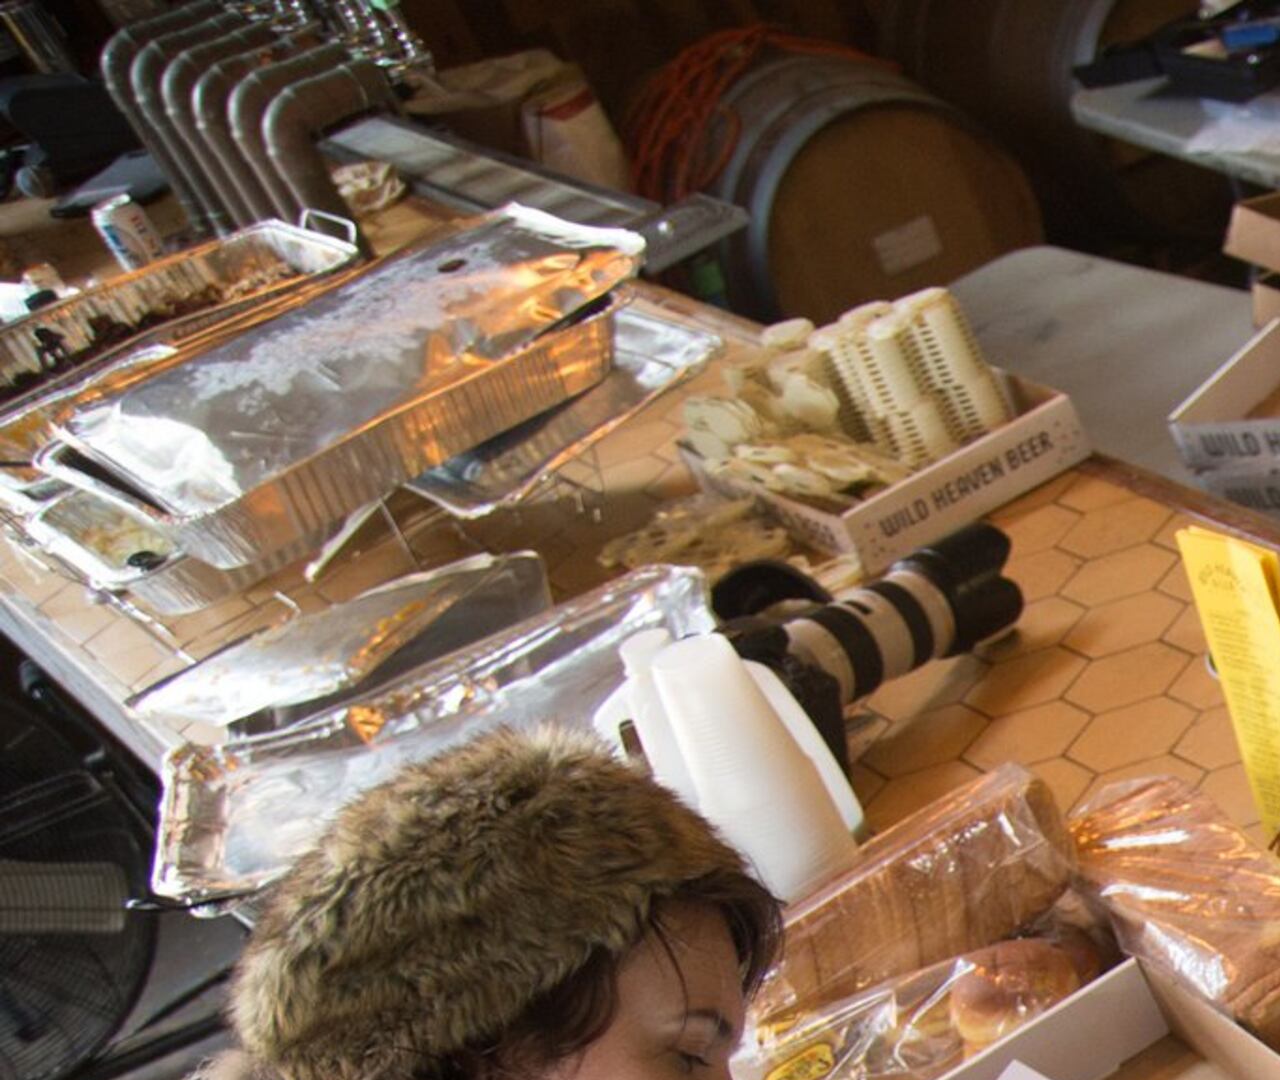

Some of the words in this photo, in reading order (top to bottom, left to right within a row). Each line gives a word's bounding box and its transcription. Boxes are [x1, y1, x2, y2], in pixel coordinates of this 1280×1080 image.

[1202, 429, 1262, 457] WILD
[878, 498, 931, 538] WILD
[934, 458, 1006, 513] HEAVEN
[1007, 430, 1054, 473] BEER
